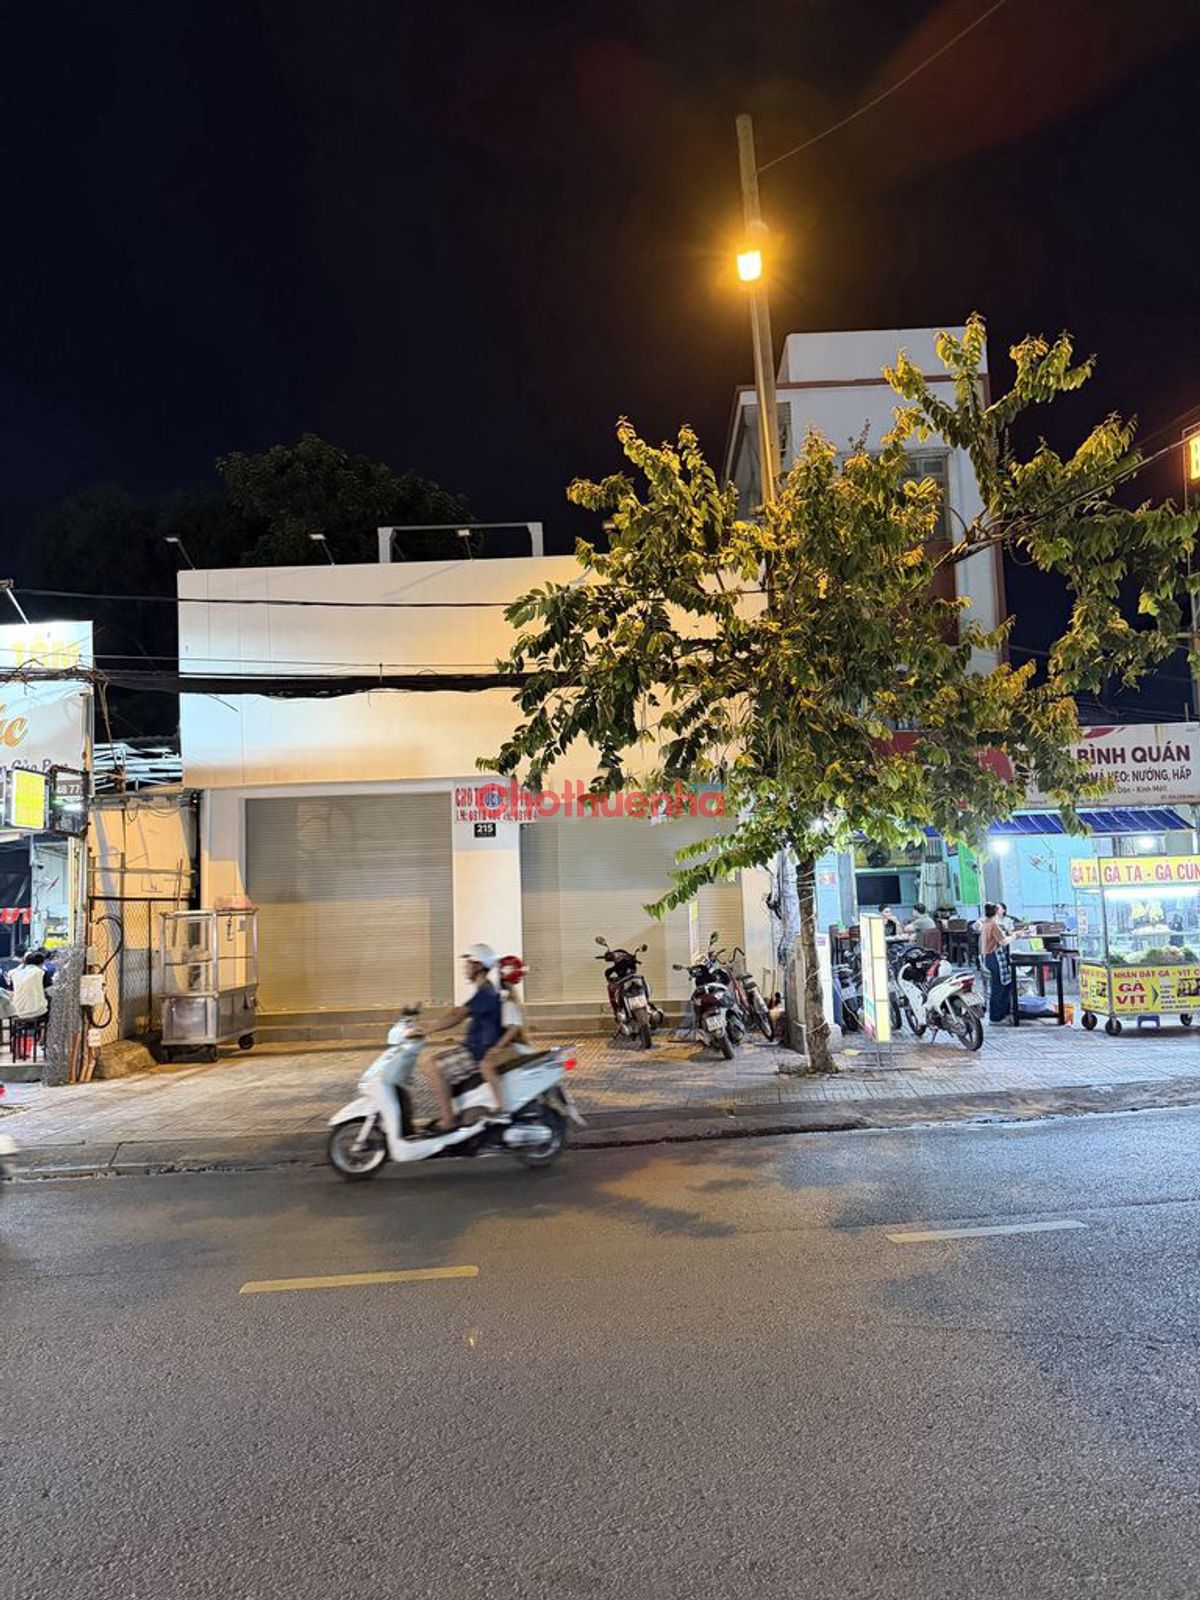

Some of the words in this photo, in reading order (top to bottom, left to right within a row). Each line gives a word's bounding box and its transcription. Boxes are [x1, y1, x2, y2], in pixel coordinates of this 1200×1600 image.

[1077, 743, 1126, 765] BÌNH
[1131, 741, 1190, 763] QUÁN
[1172, 764, 1192, 780] HẤP
[476, 824, 494, 833] 215
[1125, 865, 1143, 882] TA
[1118, 980, 1145, 992] GÀ
[1115, 995, 1148, 1007] VỊT
